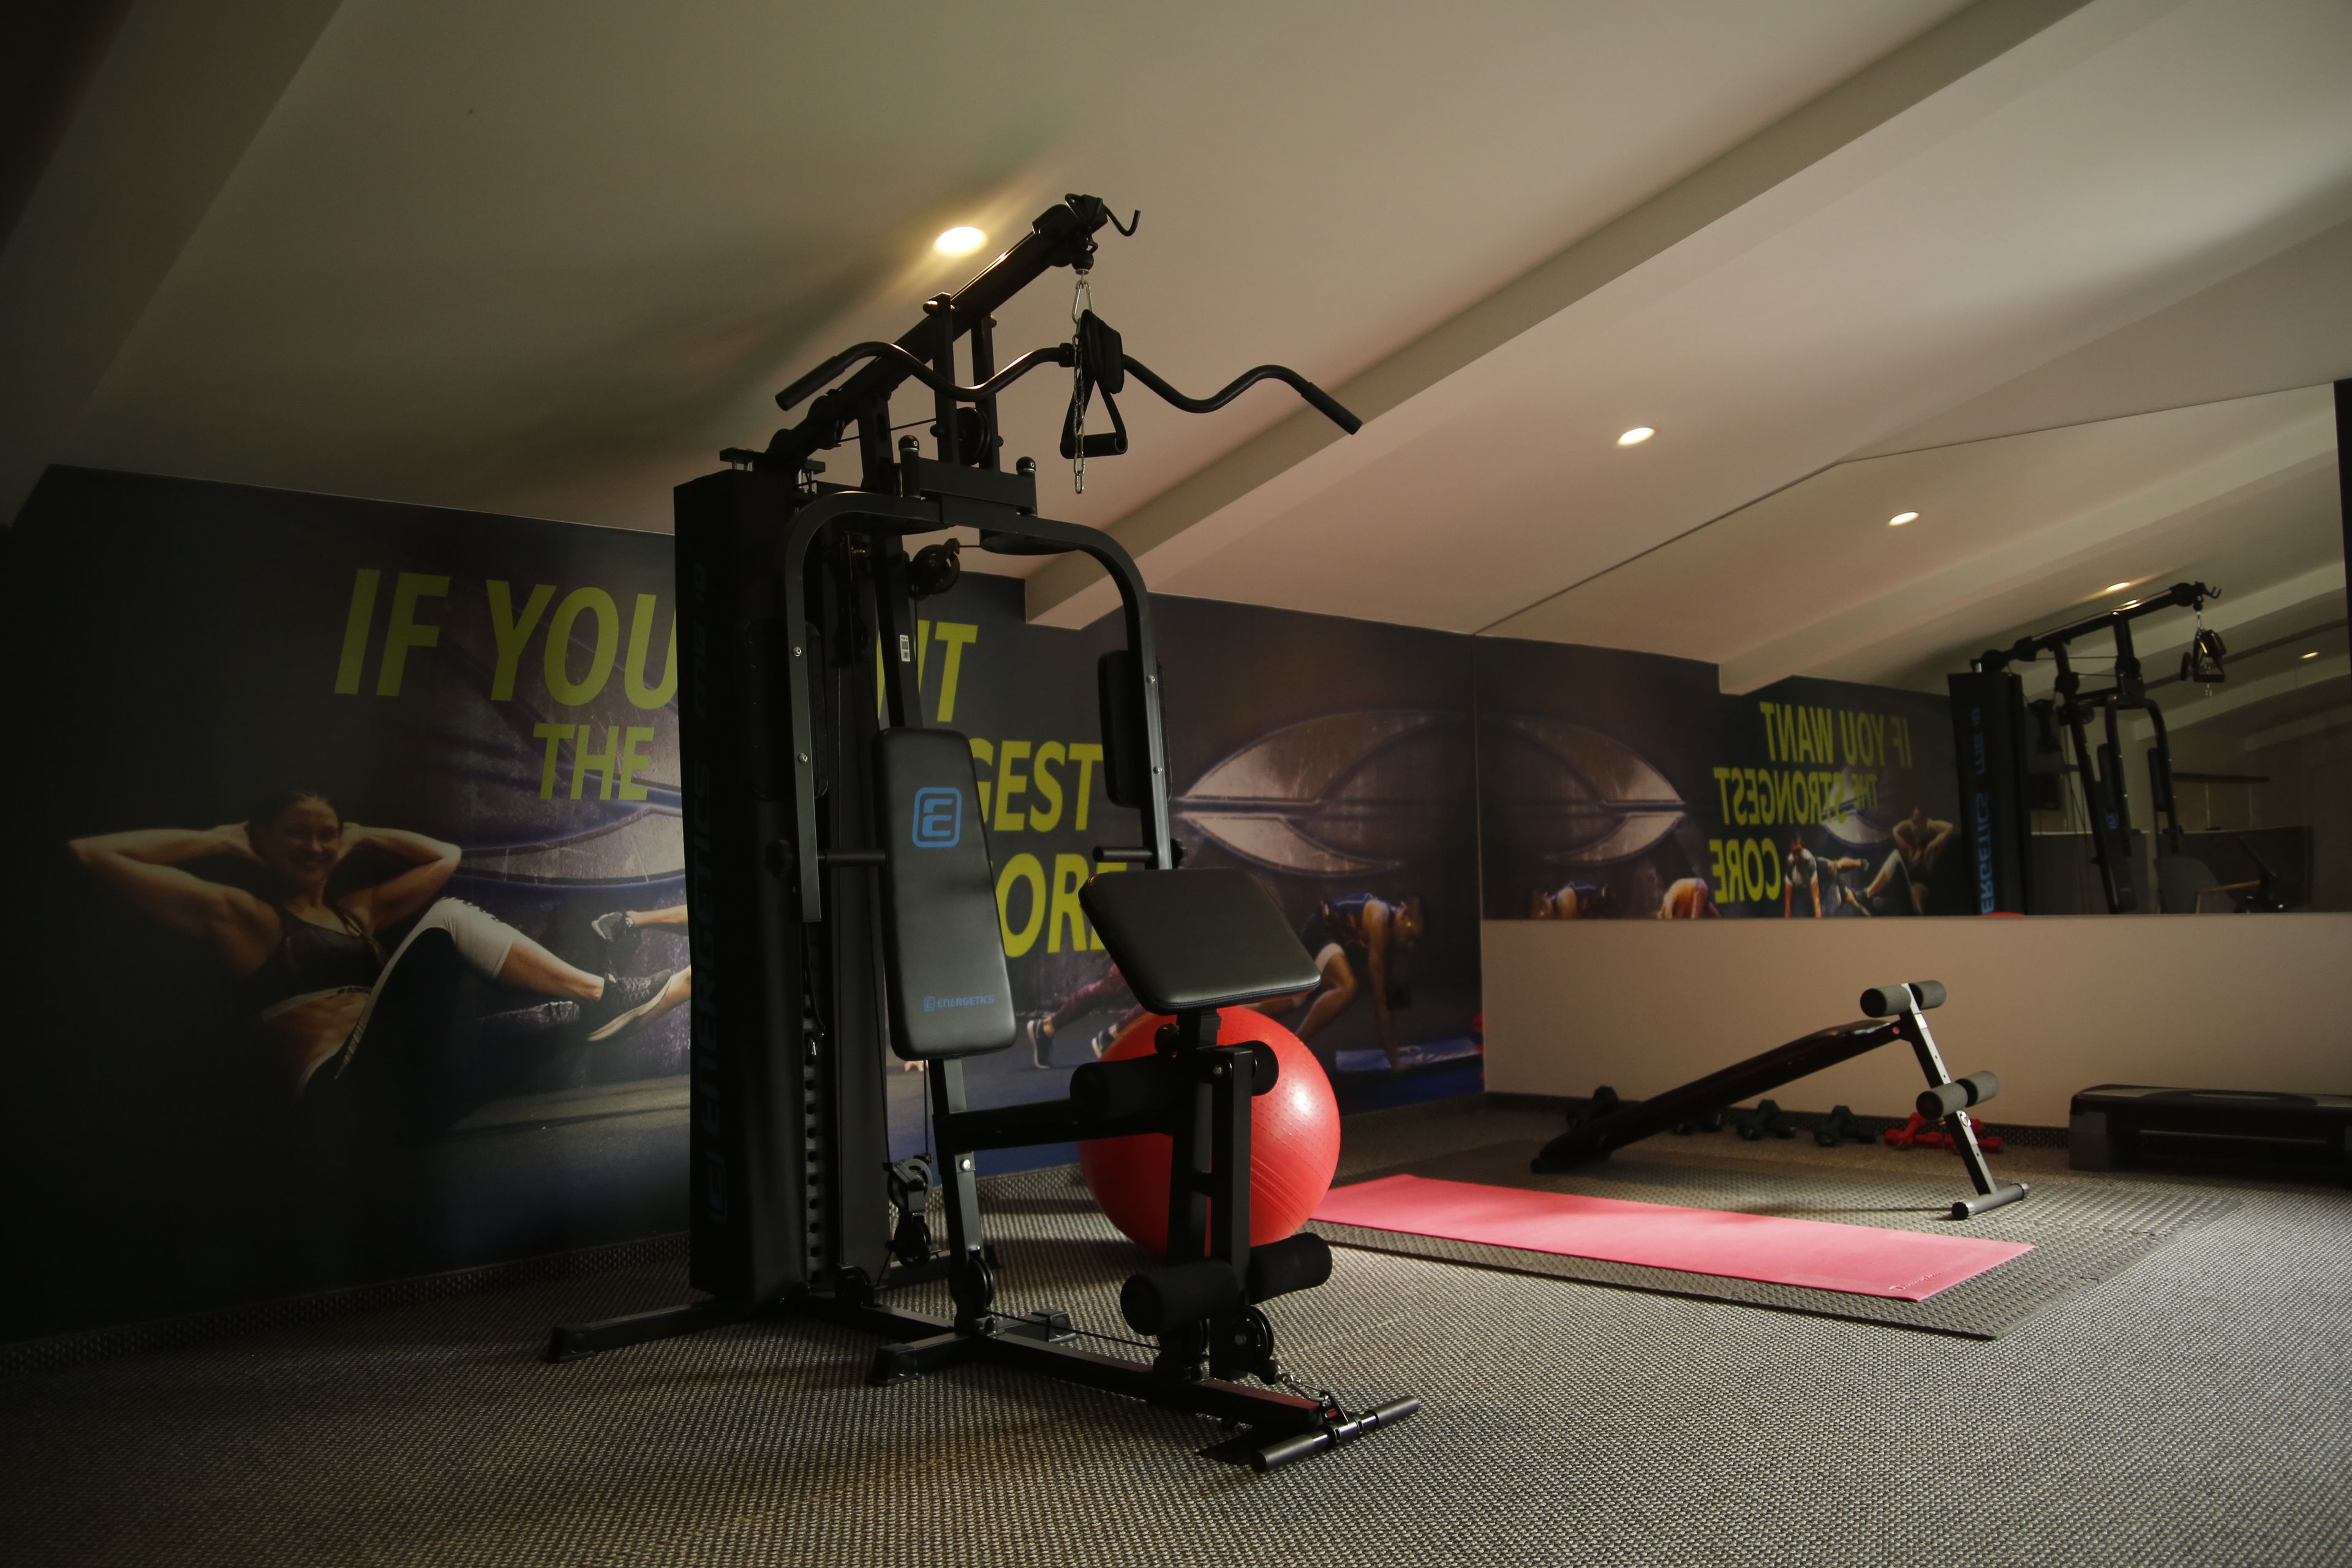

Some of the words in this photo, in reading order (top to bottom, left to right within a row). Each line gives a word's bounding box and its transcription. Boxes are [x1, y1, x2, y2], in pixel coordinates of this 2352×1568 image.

[334, 568, 450, 697] IF
[485, 579, 678, 710] YOU
[532, 722, 655, 801] THE
[990, 853, 1128, 958] OR
[937, 995, 995, 1008] ENERGETICS
